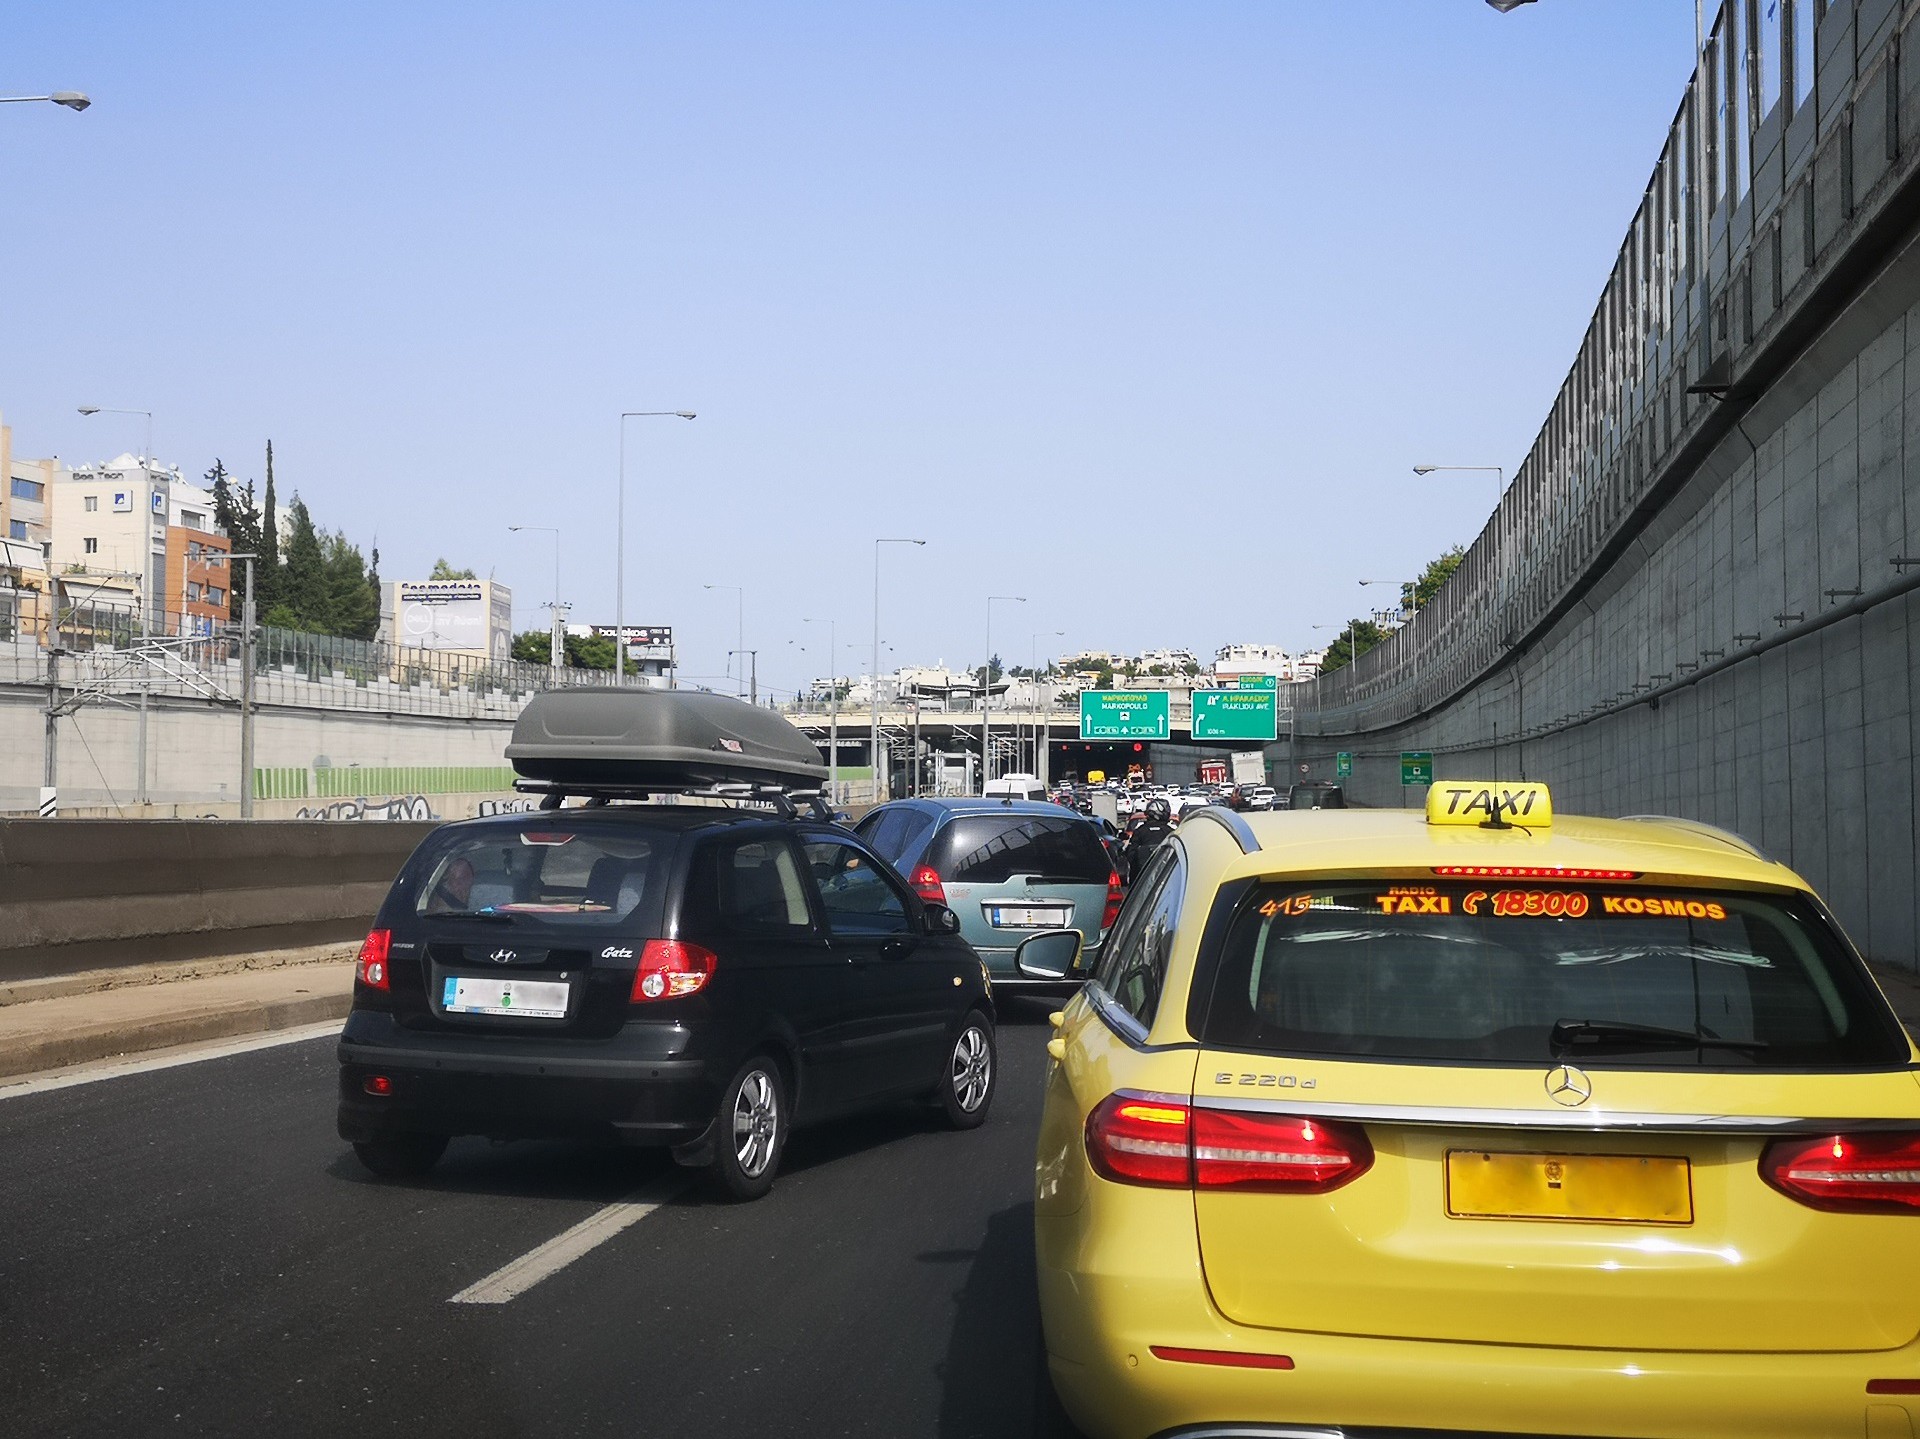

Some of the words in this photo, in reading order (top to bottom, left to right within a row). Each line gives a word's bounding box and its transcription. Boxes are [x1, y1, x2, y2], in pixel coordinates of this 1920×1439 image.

[1446, 789, 1536, 816] TAXI
[1389, 887, 1436, 896] RADIO
[1259, 894, 1313, 916] 415
[1376, 896, 1451, 915] TAXI
[1492, 890, 1589, 918] 18300
[1602, 897, 1727, 920] KOSMOS
[601, 946, 633, 958] Getz
[1215, 1073, 1233, 1084] E
